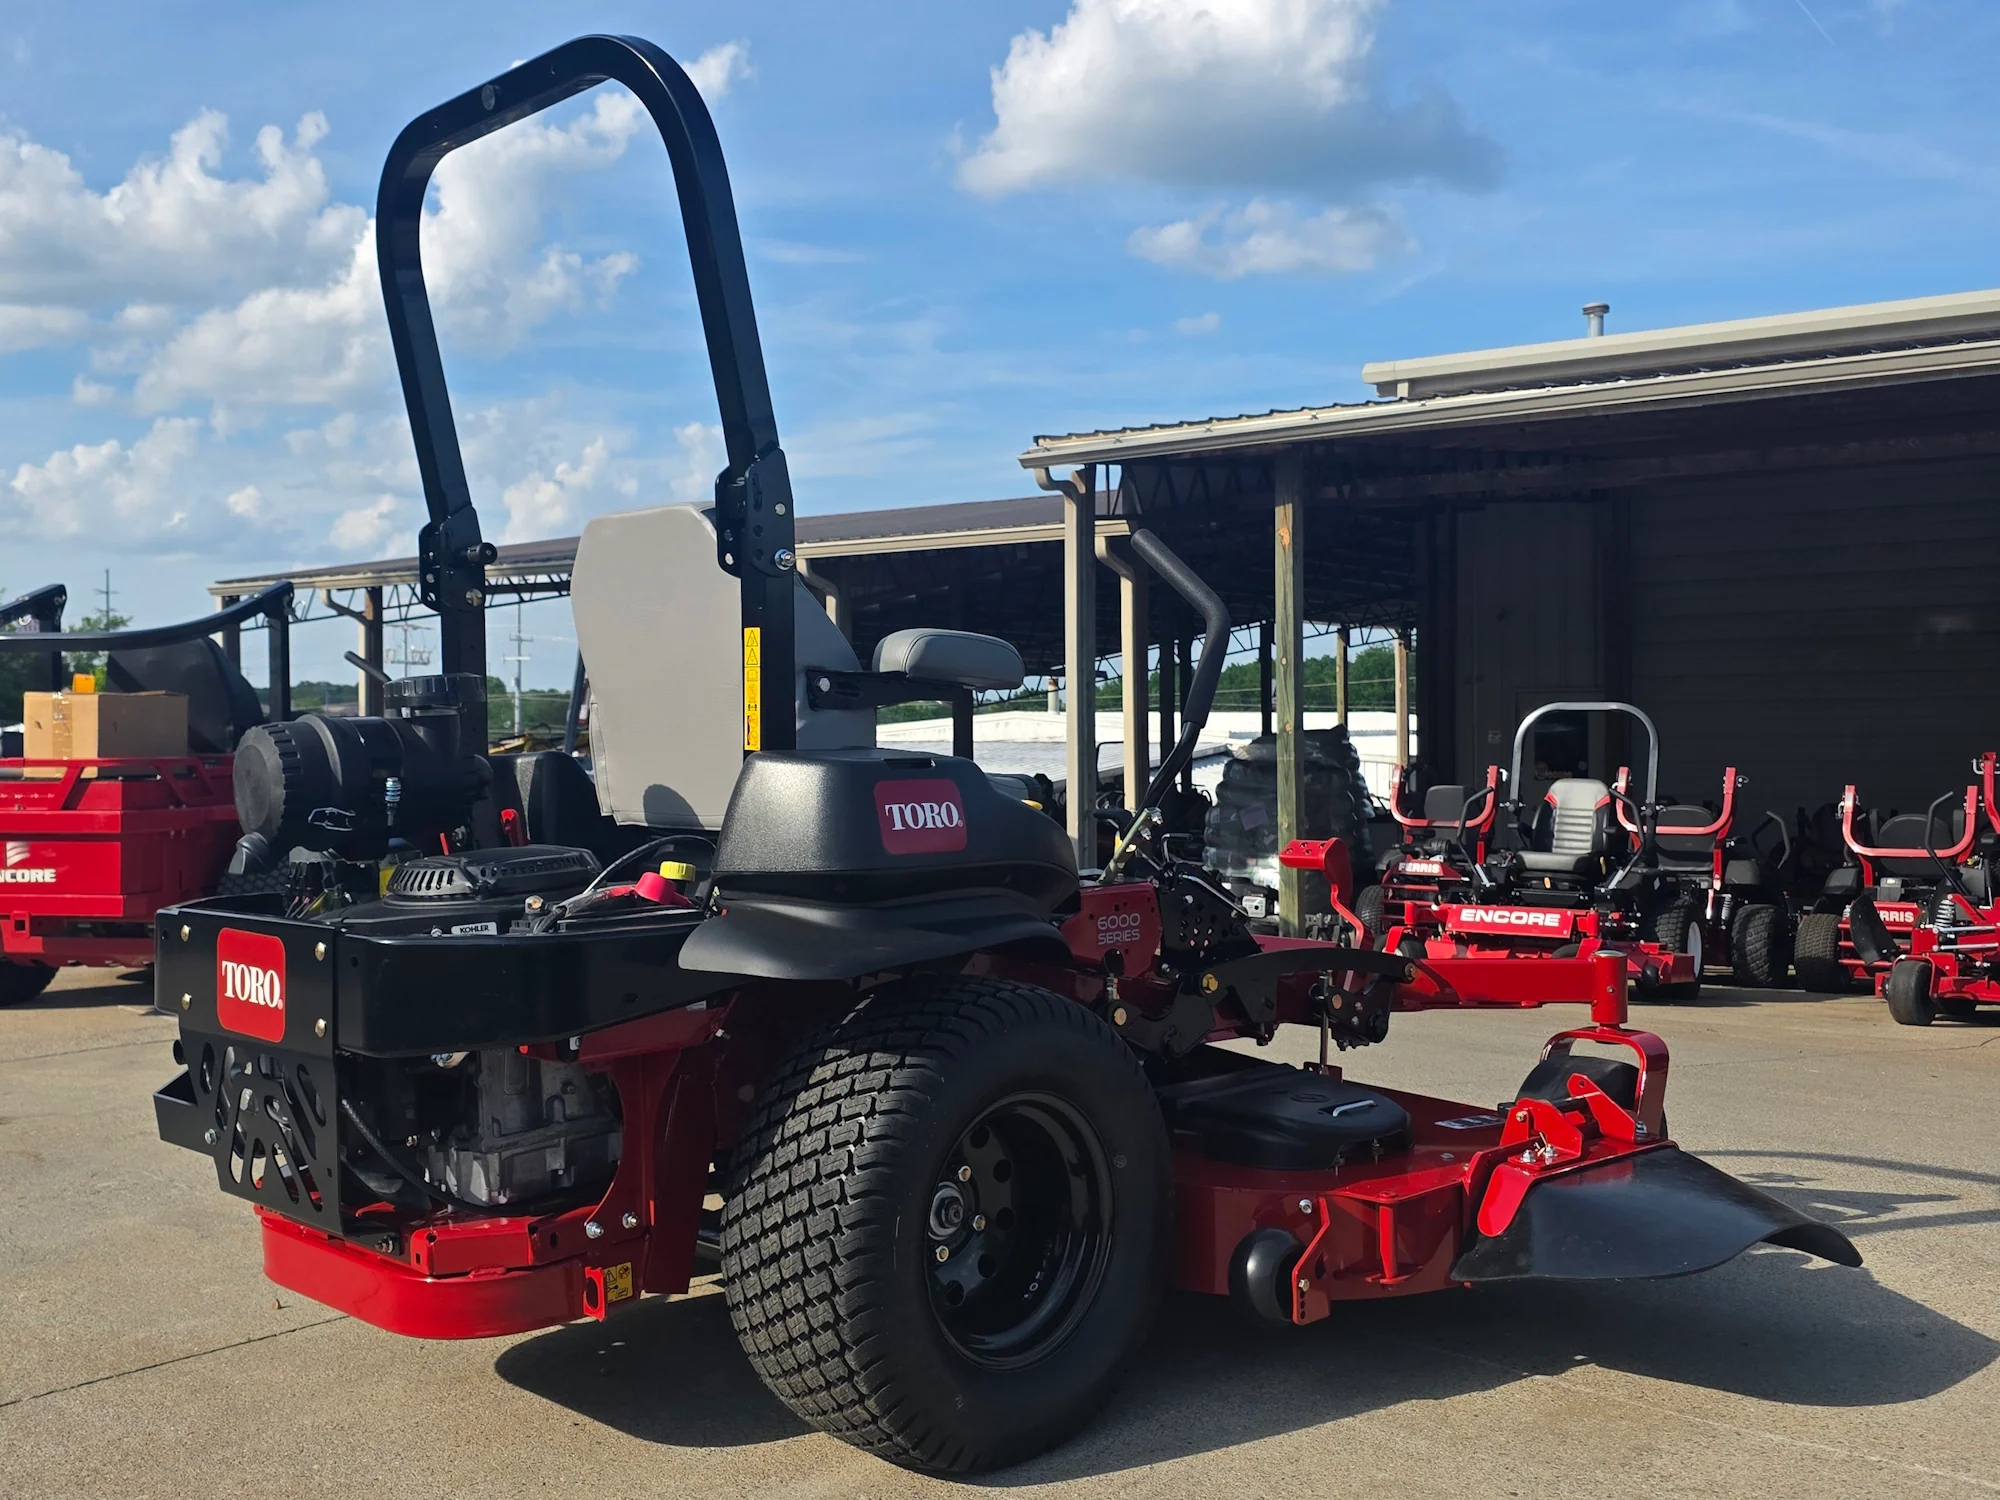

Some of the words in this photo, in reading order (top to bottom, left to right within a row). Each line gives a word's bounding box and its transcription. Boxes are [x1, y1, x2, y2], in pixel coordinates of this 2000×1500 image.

[885, 801, 959, 830] TORO
[1398, 862, 1440, 873] FERRIS
[1097, 913, 1140, 930] 6000
[1460, 908, 1560, 927] ENCORE
[1877, 910, 1914, 923] RRIS
[459, 925, 489, 934] KOHLER
[1097, 929, 1140, 945] SERIES
[221, 960, 281, 1008] TORO
